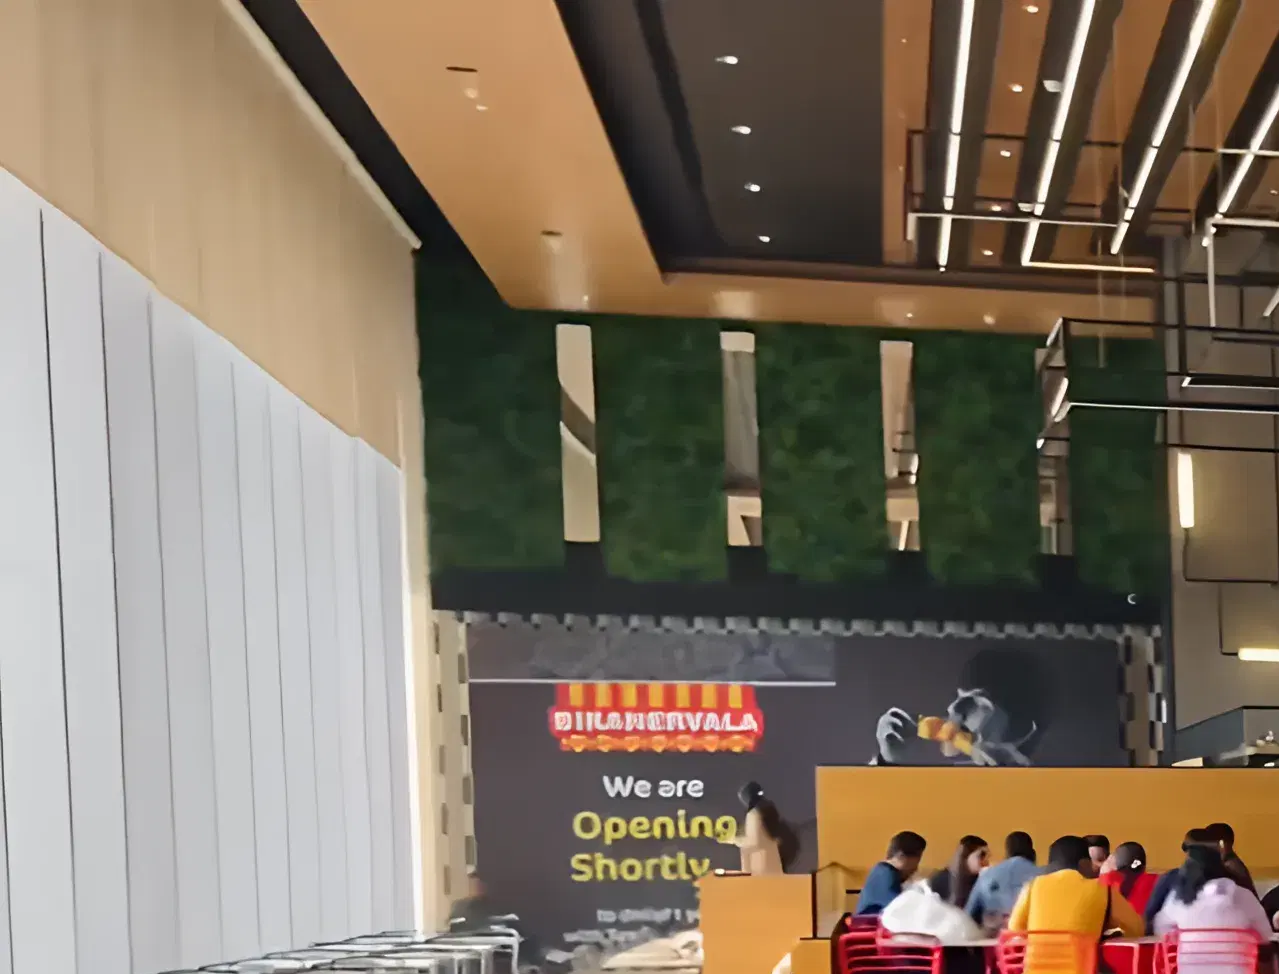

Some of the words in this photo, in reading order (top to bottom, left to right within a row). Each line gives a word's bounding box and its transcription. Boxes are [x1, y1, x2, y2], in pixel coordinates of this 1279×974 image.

[603, 776, 651, 798] We
[658, 779, 704, 798] are
[573, 809, 737, 845] Opening
[570, 852, 711, 881] Shortly
